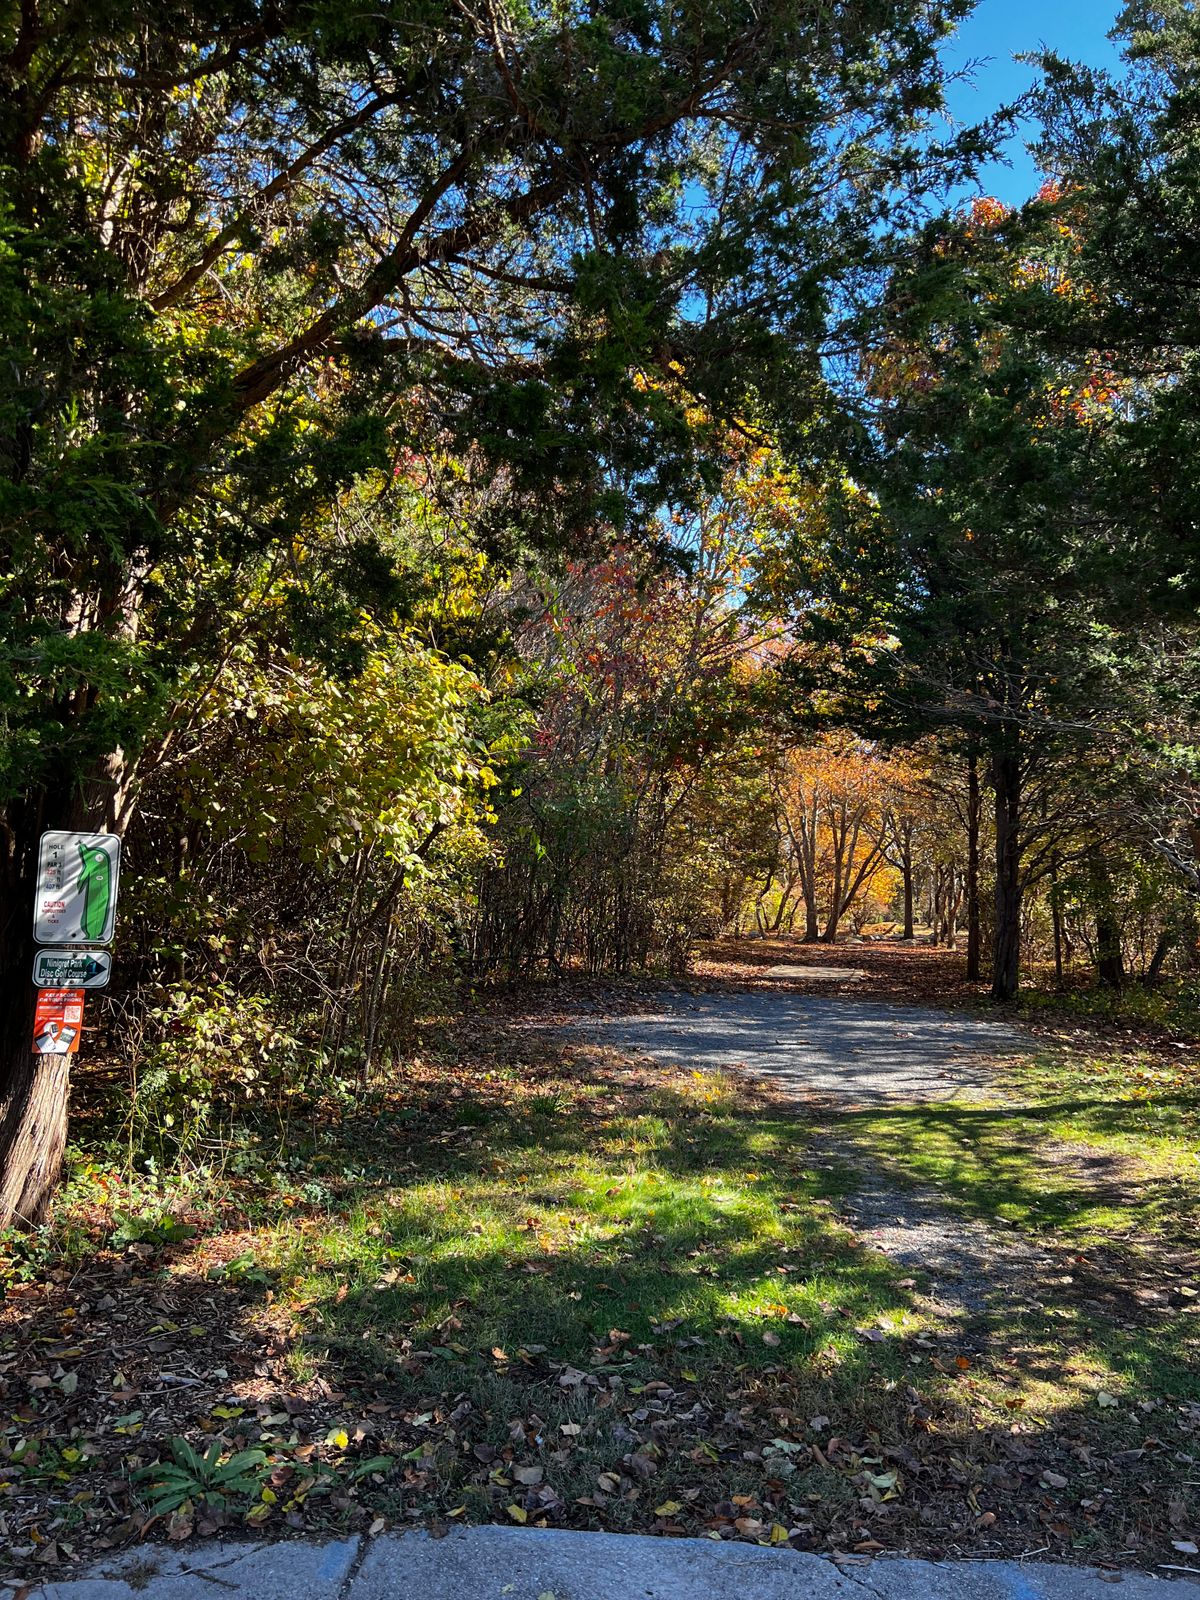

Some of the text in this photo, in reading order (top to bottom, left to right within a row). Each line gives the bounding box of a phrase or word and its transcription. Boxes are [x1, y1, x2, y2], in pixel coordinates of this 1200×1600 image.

[53, 851, 58, 859] 1
[47, 959, 83, 969] Ninigret Park
[40, 969, 87, 978] Disc Golf Course
